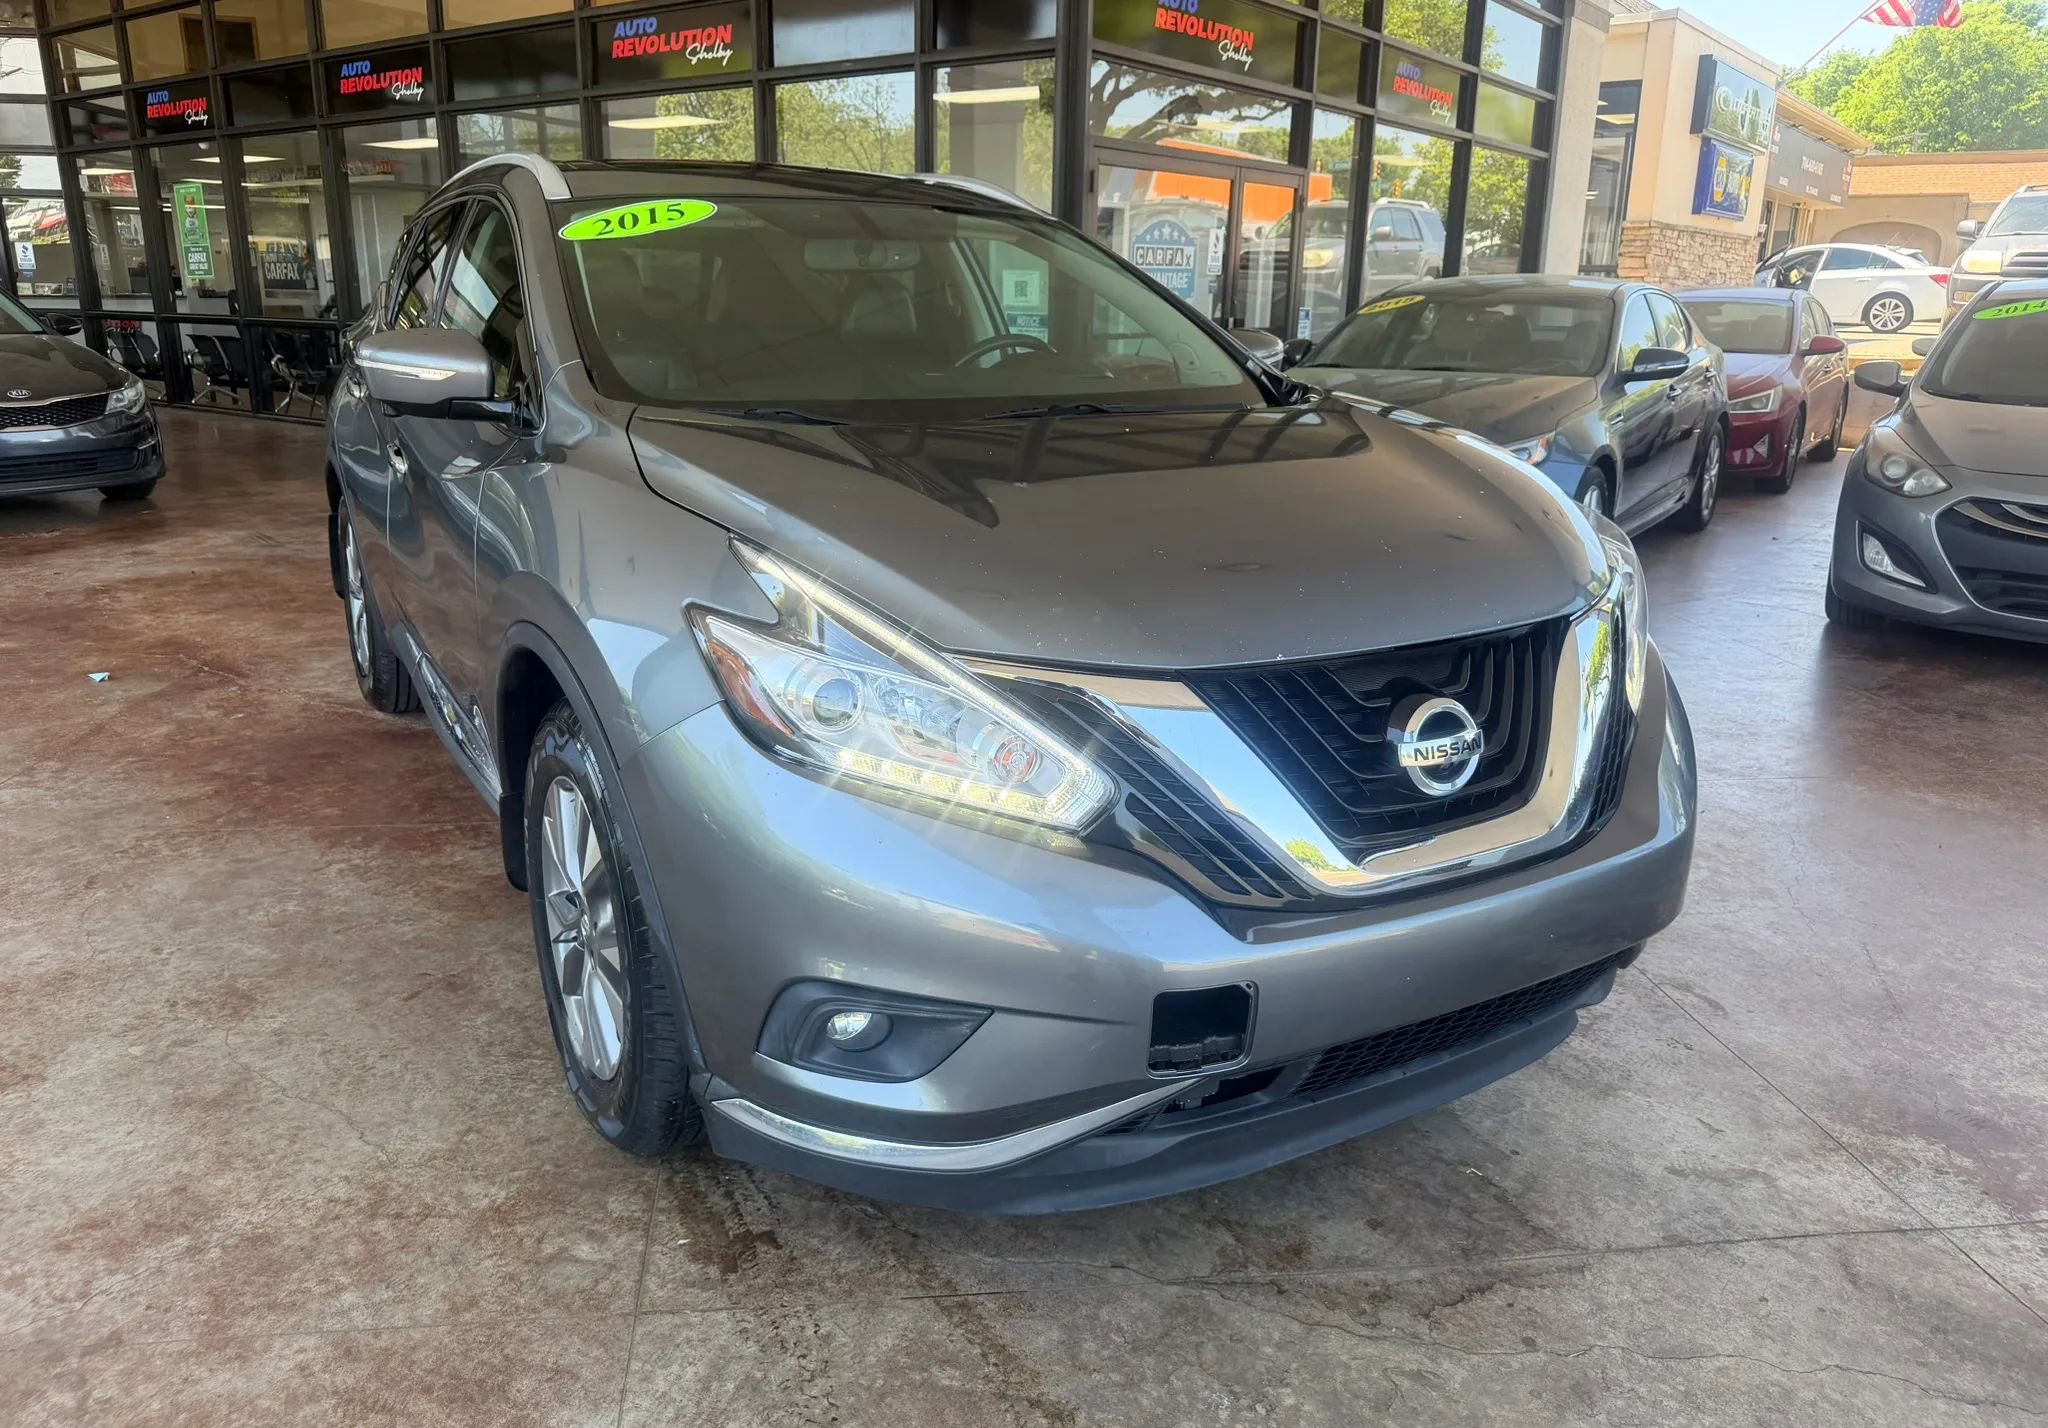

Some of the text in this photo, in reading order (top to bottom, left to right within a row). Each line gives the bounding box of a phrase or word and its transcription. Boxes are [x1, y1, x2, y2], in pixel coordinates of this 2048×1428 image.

[613, 17, 658, 38] AUTO
[1155, 7, 1254, 51] REVOLUTION
[611, 24, 733, 58] REVOLUTION
[685, 38, 733, 66] Shelby
[1218, 40, 1254, 71] Shelby
[340, 66, 423, 94] REVOLUTION
[341, 60, 371, 77] AUTO
[1396, 62, 1421, 80] AUTO
[147, 90, 169, 104] AUTO
[391, 78, 424, 102] Shelby
[1393, 75, 1454, 108] REVOLUTION
[146, 97, 207, 118] REVOLUTION
[592, 203, 685, 236] 2015
[1135, 246, 1192, 268] CARFAX
[264, 262, 300, 280] CARFAX
[1148, 271, 1189, 288] ANTAGE
[1991, 300, 2048, 316] 2014
[1413, 736, 1482, 761] NISSAN
